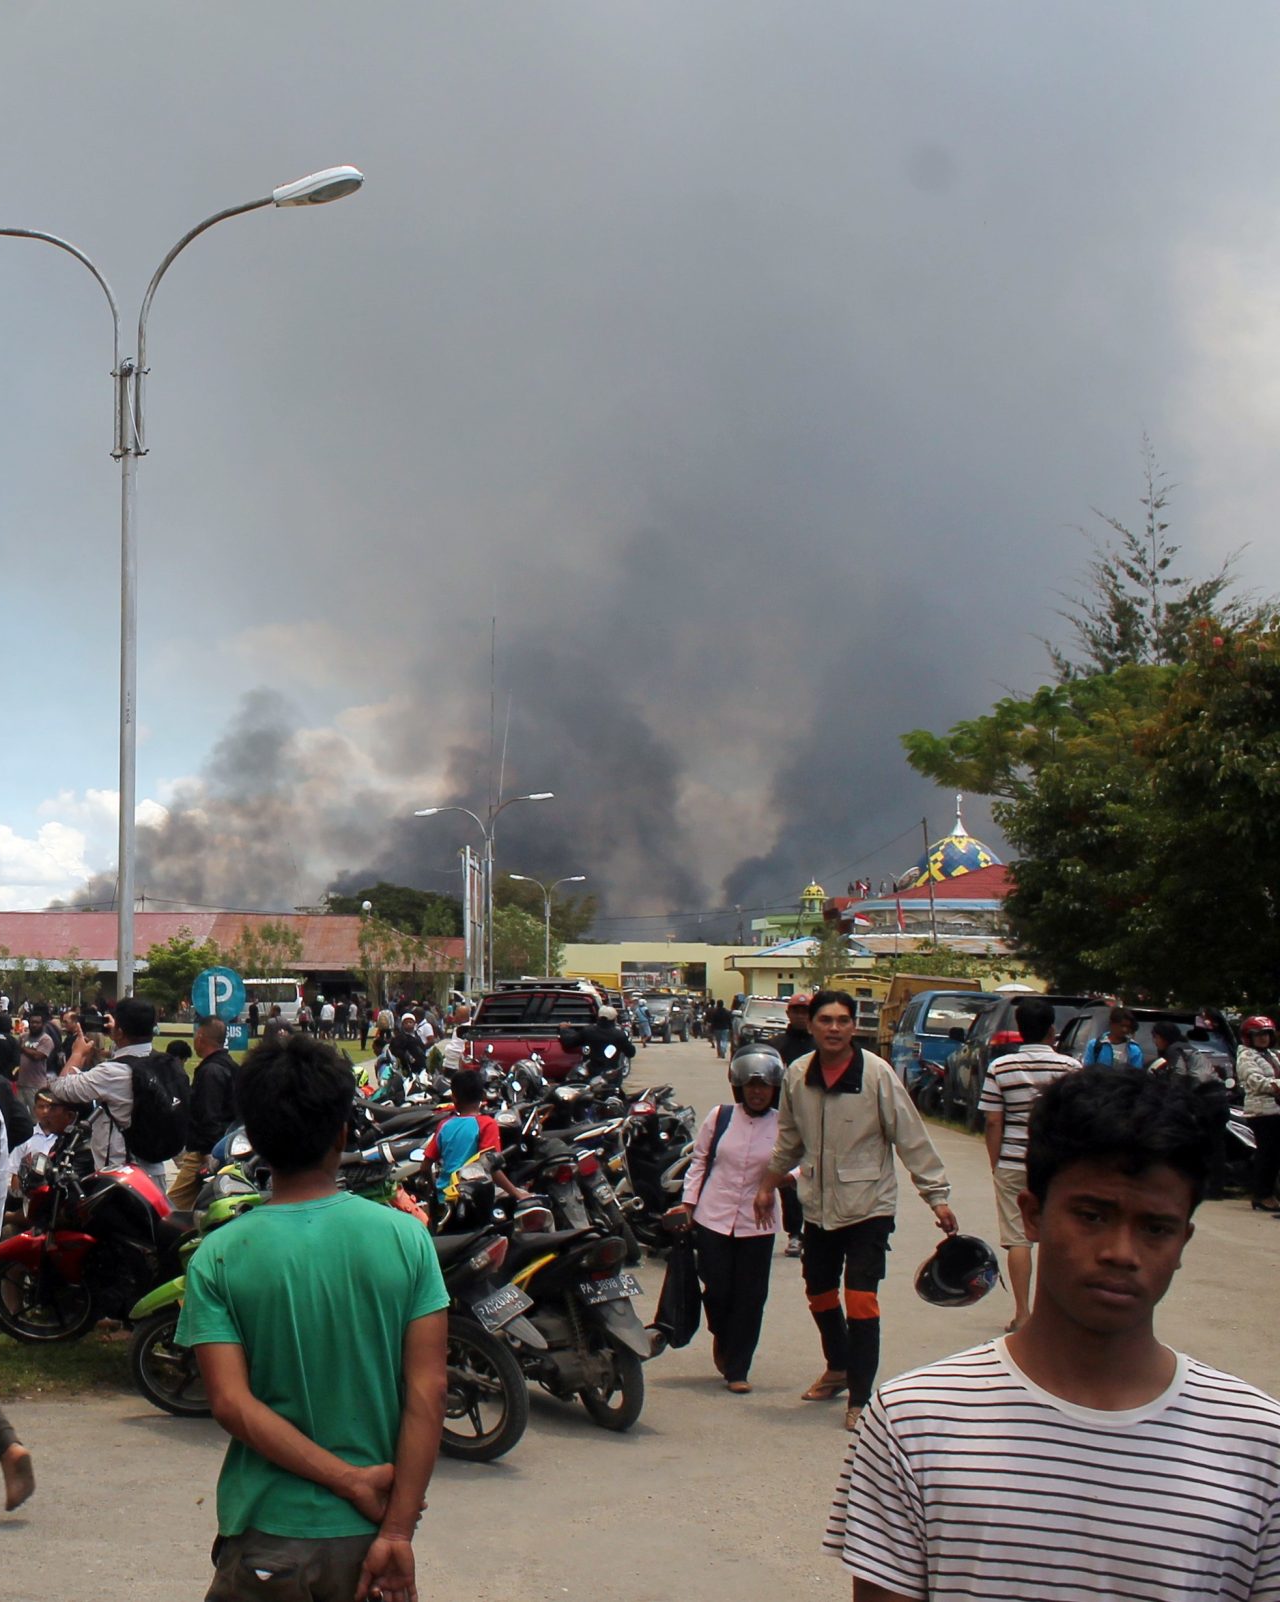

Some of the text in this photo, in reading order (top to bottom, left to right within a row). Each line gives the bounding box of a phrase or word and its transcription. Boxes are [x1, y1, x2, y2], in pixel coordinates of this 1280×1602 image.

[208, 975, 233, 1016] P
[579, 1283, 594, 1294] PA
[618, 1274, 634, 1286] BG
